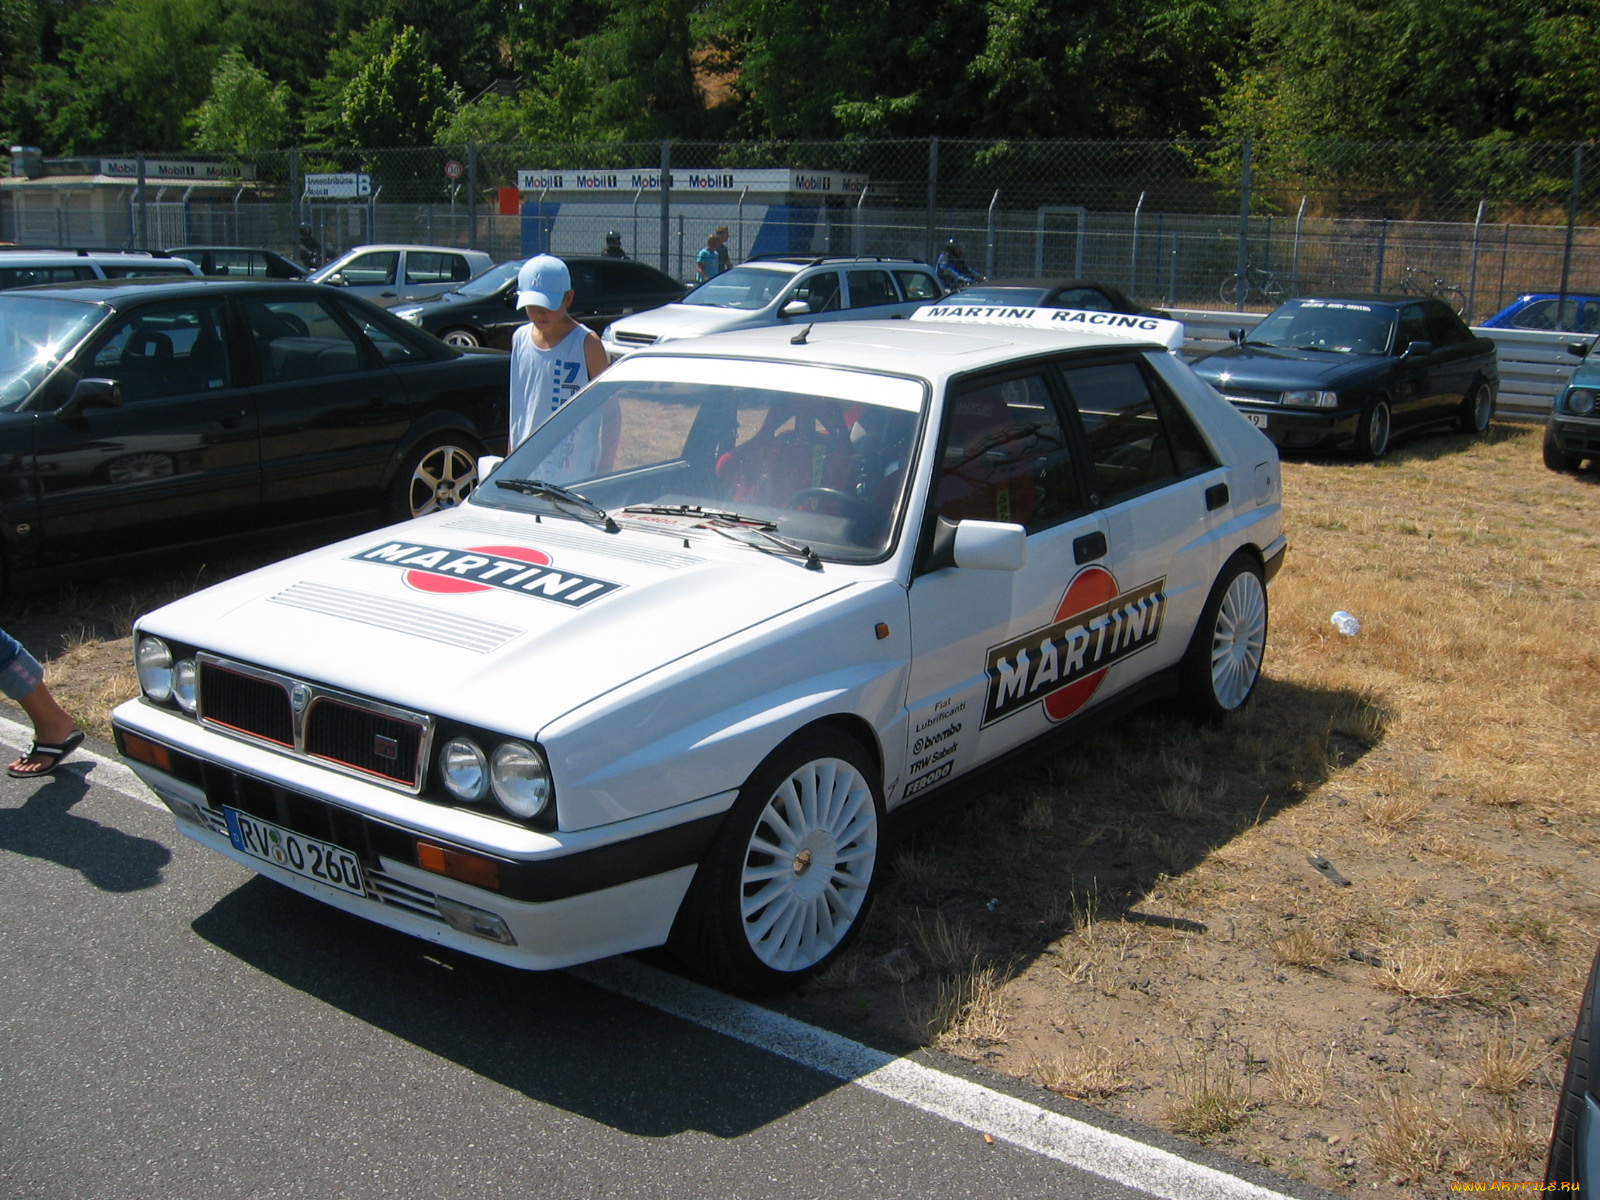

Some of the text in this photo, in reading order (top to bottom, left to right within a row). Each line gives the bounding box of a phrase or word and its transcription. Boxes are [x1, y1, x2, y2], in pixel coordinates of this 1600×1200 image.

[108, 162, 136, 174] Mobil
[158, 165, 185, 176] Mobil
[449, 165, 459, 175] 30
[524, 175, 553, 188] Mobil
[576, 175, 607, 188] Mobil
[689, 175, 722, 188] Mobil
[795, 175, 822, 190] Mobil
[927, 306, 1159, 331] MARTINI RACING
[365, 542, 604, 603] MARTINI
[995, 591, 1161, 708] MARTINI
[934, 697, 952, 712] Fiat
[915, 701, 966, 733] Lubrificanti
[923, 722, 962, 750] brembo
[909, 754, 932, 775] TRW
[905, 763, 951, 797] FERODO
[238, 817, 270, 857] RV
[306, 843, 361, 890] 260
